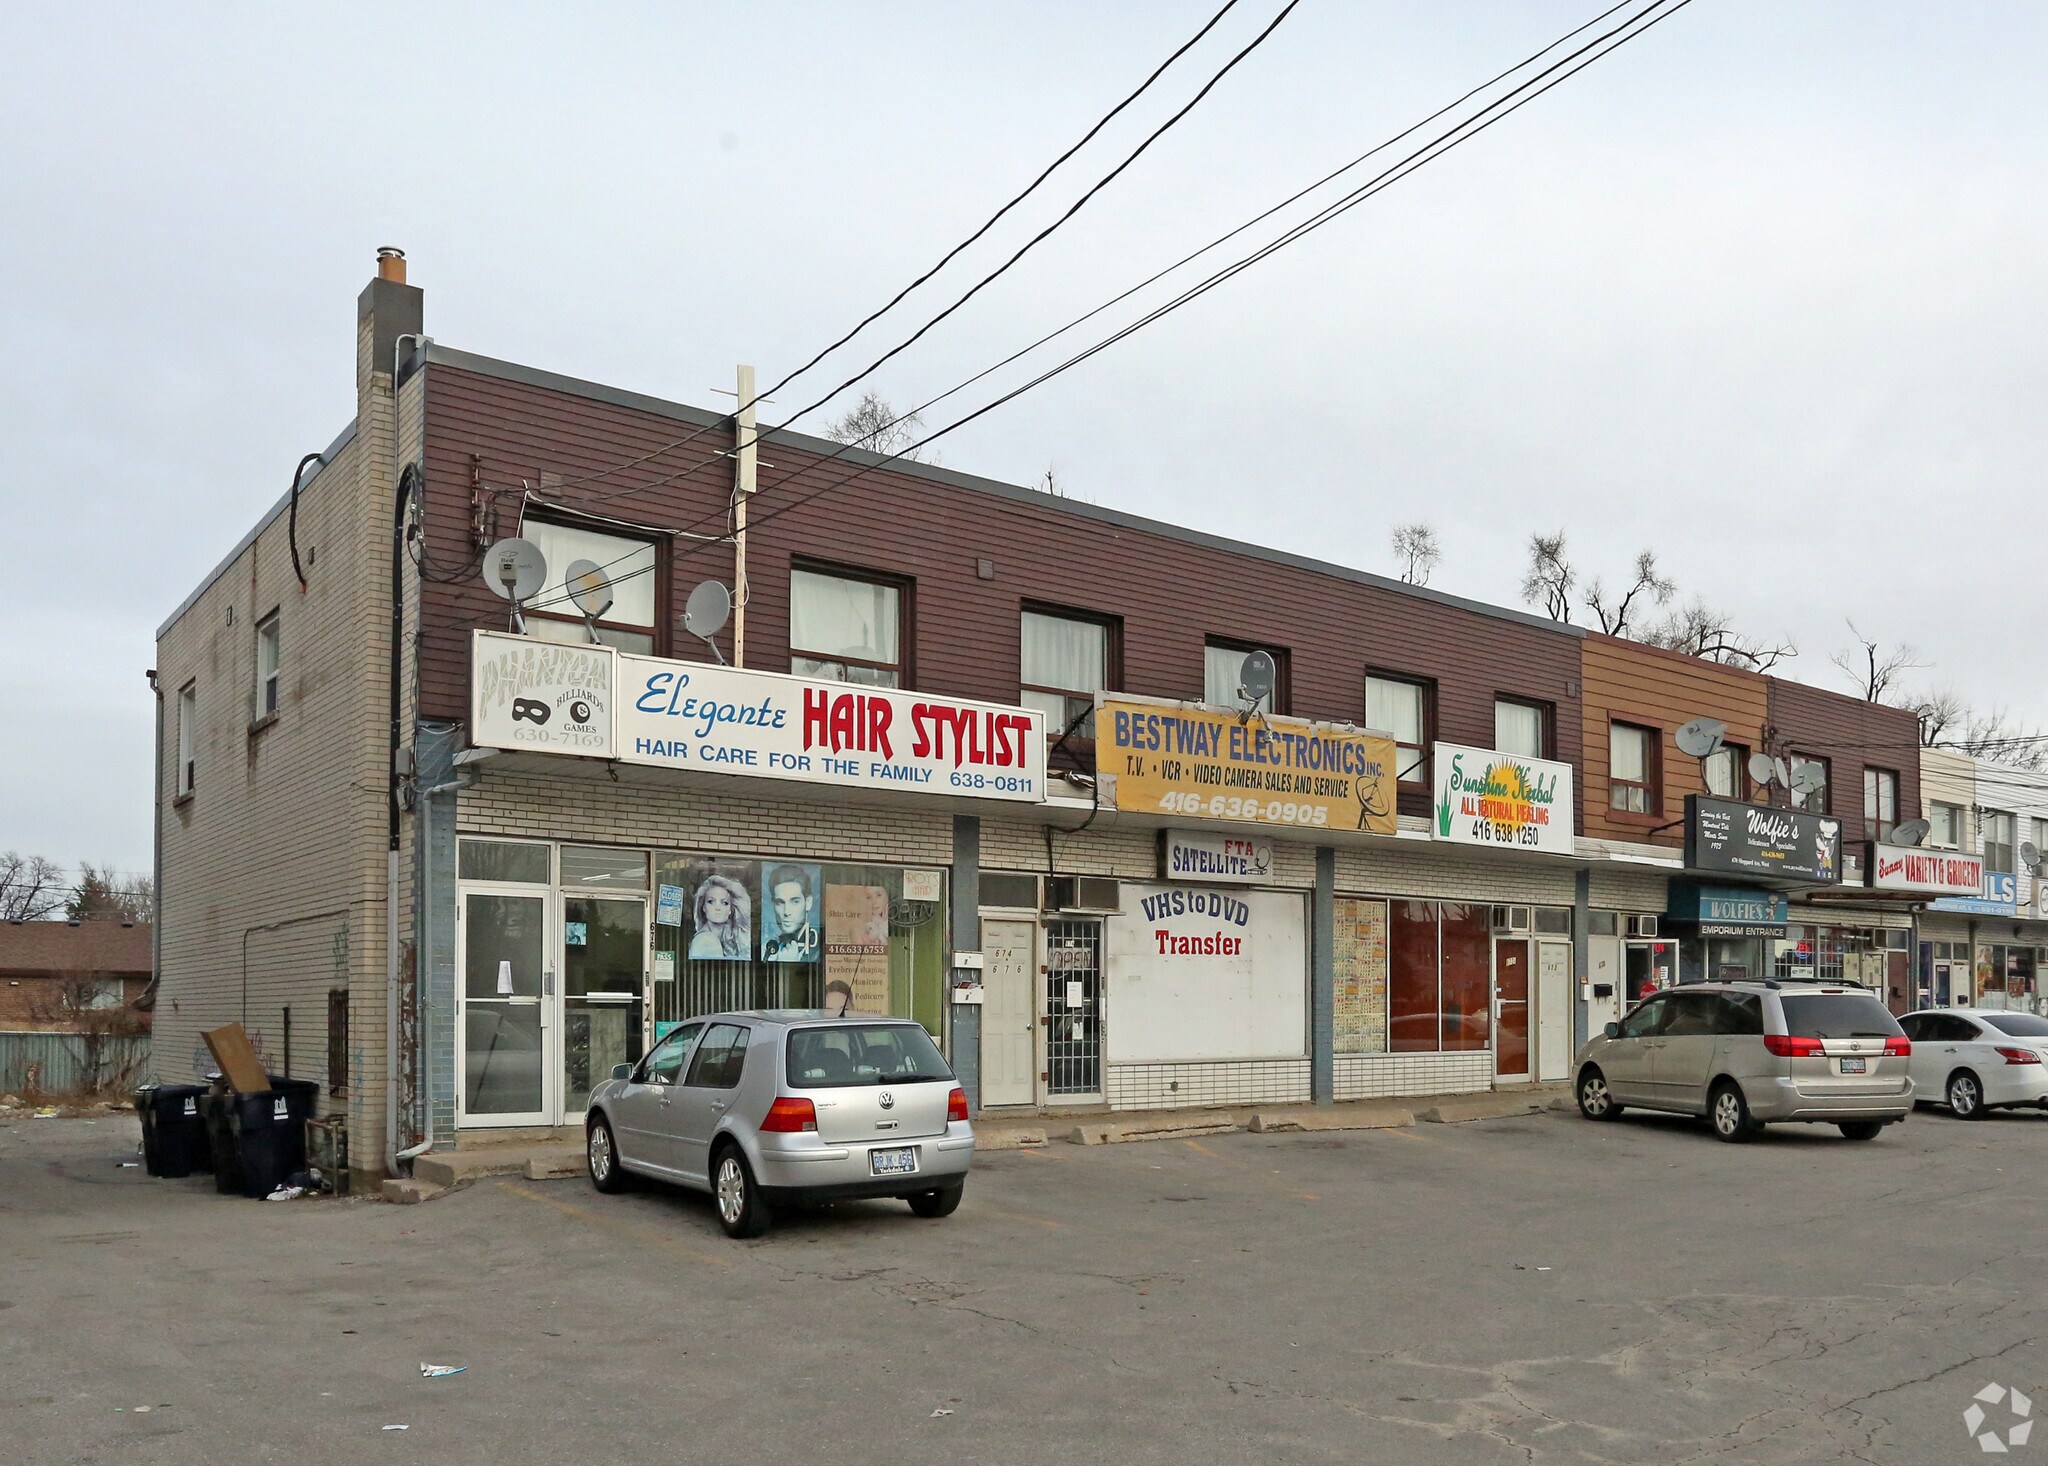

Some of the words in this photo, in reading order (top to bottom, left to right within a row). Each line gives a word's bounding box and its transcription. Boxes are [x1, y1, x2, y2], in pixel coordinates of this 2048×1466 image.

[556, 688, 605, 714] BILLIARDS
[563, 723, 597, 734] GAMES
[635, 672, 787, 738] Elegante
[803, 687, 894, 762] HAIR
[911, 702, 1033, 770] STYLIST
[513, 727, 604, 748] 630-7169
[1114, 710, 1222, 758] BESTWAY
[1229, 725, 1366, 777] ELECTRONICS
[1366, 761, 1385, 778] INC.
[635, 737, 688, 758] HAIR
[699, 744, 758, 766] CARE
[769, 752, 811, 772] FOR
[821, 757, 860, 776] THE
[870, 763, 933, 783] FAMILY
[949, 771, 1032, 793] 638-0811
[1126, 755, 1145, 778] T.V.
[1161, 759, 1181, 781] VCR
[1193, 763, 1222, 785] VIDEO
[1224, 766, 1262, 789] CAMERA
[1264, 771, 1291, 793] SALES
[1294, 774, 1312, 795] AND
[1313, 776, 1349, 799] SERVICE
[1450, 753, 1508, 797] Sunshine
[1512, 764, 1557, 805] Herbal
[1158, 791, 1328, 825] 416-636-0905
[1460, 796, 1476, 817] ALL
[1477, 799, 1514, 821] NATURAL
[1516, 803, 1549, 826] HEALING
[1472, 820, 1491, 841] 416
[1495, 823, 1513, 843] 638
[1516, 825, 1539, 846] 1250
[1746, 809, 1799, 845] Wolfie's
[1173, 845, 1248, 876] SATELLITE
[1224, 839, 1254, 856] FTA
[1905, 854, 1937, 884] VARIETY
[1938, 858, 1944, 884] &
[1947, 859, 1980, 888] GROCERY
[661, 889, 682, 902] CLOSED
[1141, 890, 1183, 921] VHS
[1187, 890, 1205, 914] to
[1208, 892, 1249, 927] DVD
[828, 910, 844, 918] Skin
[845, 911, 861, 919] Care
[1155, 929, 1242, 956] Transfer
[1701, 925, 1744, 936] EMPORIUM
[1745, 927, 1784, 937] ENTRANCE
[656, 953, 672, 961] PASS
[828, 945, 885, 954] 416.633.6753
[995, 949, 1012, 958] 674
[860, 966, 886, 976] shaping
